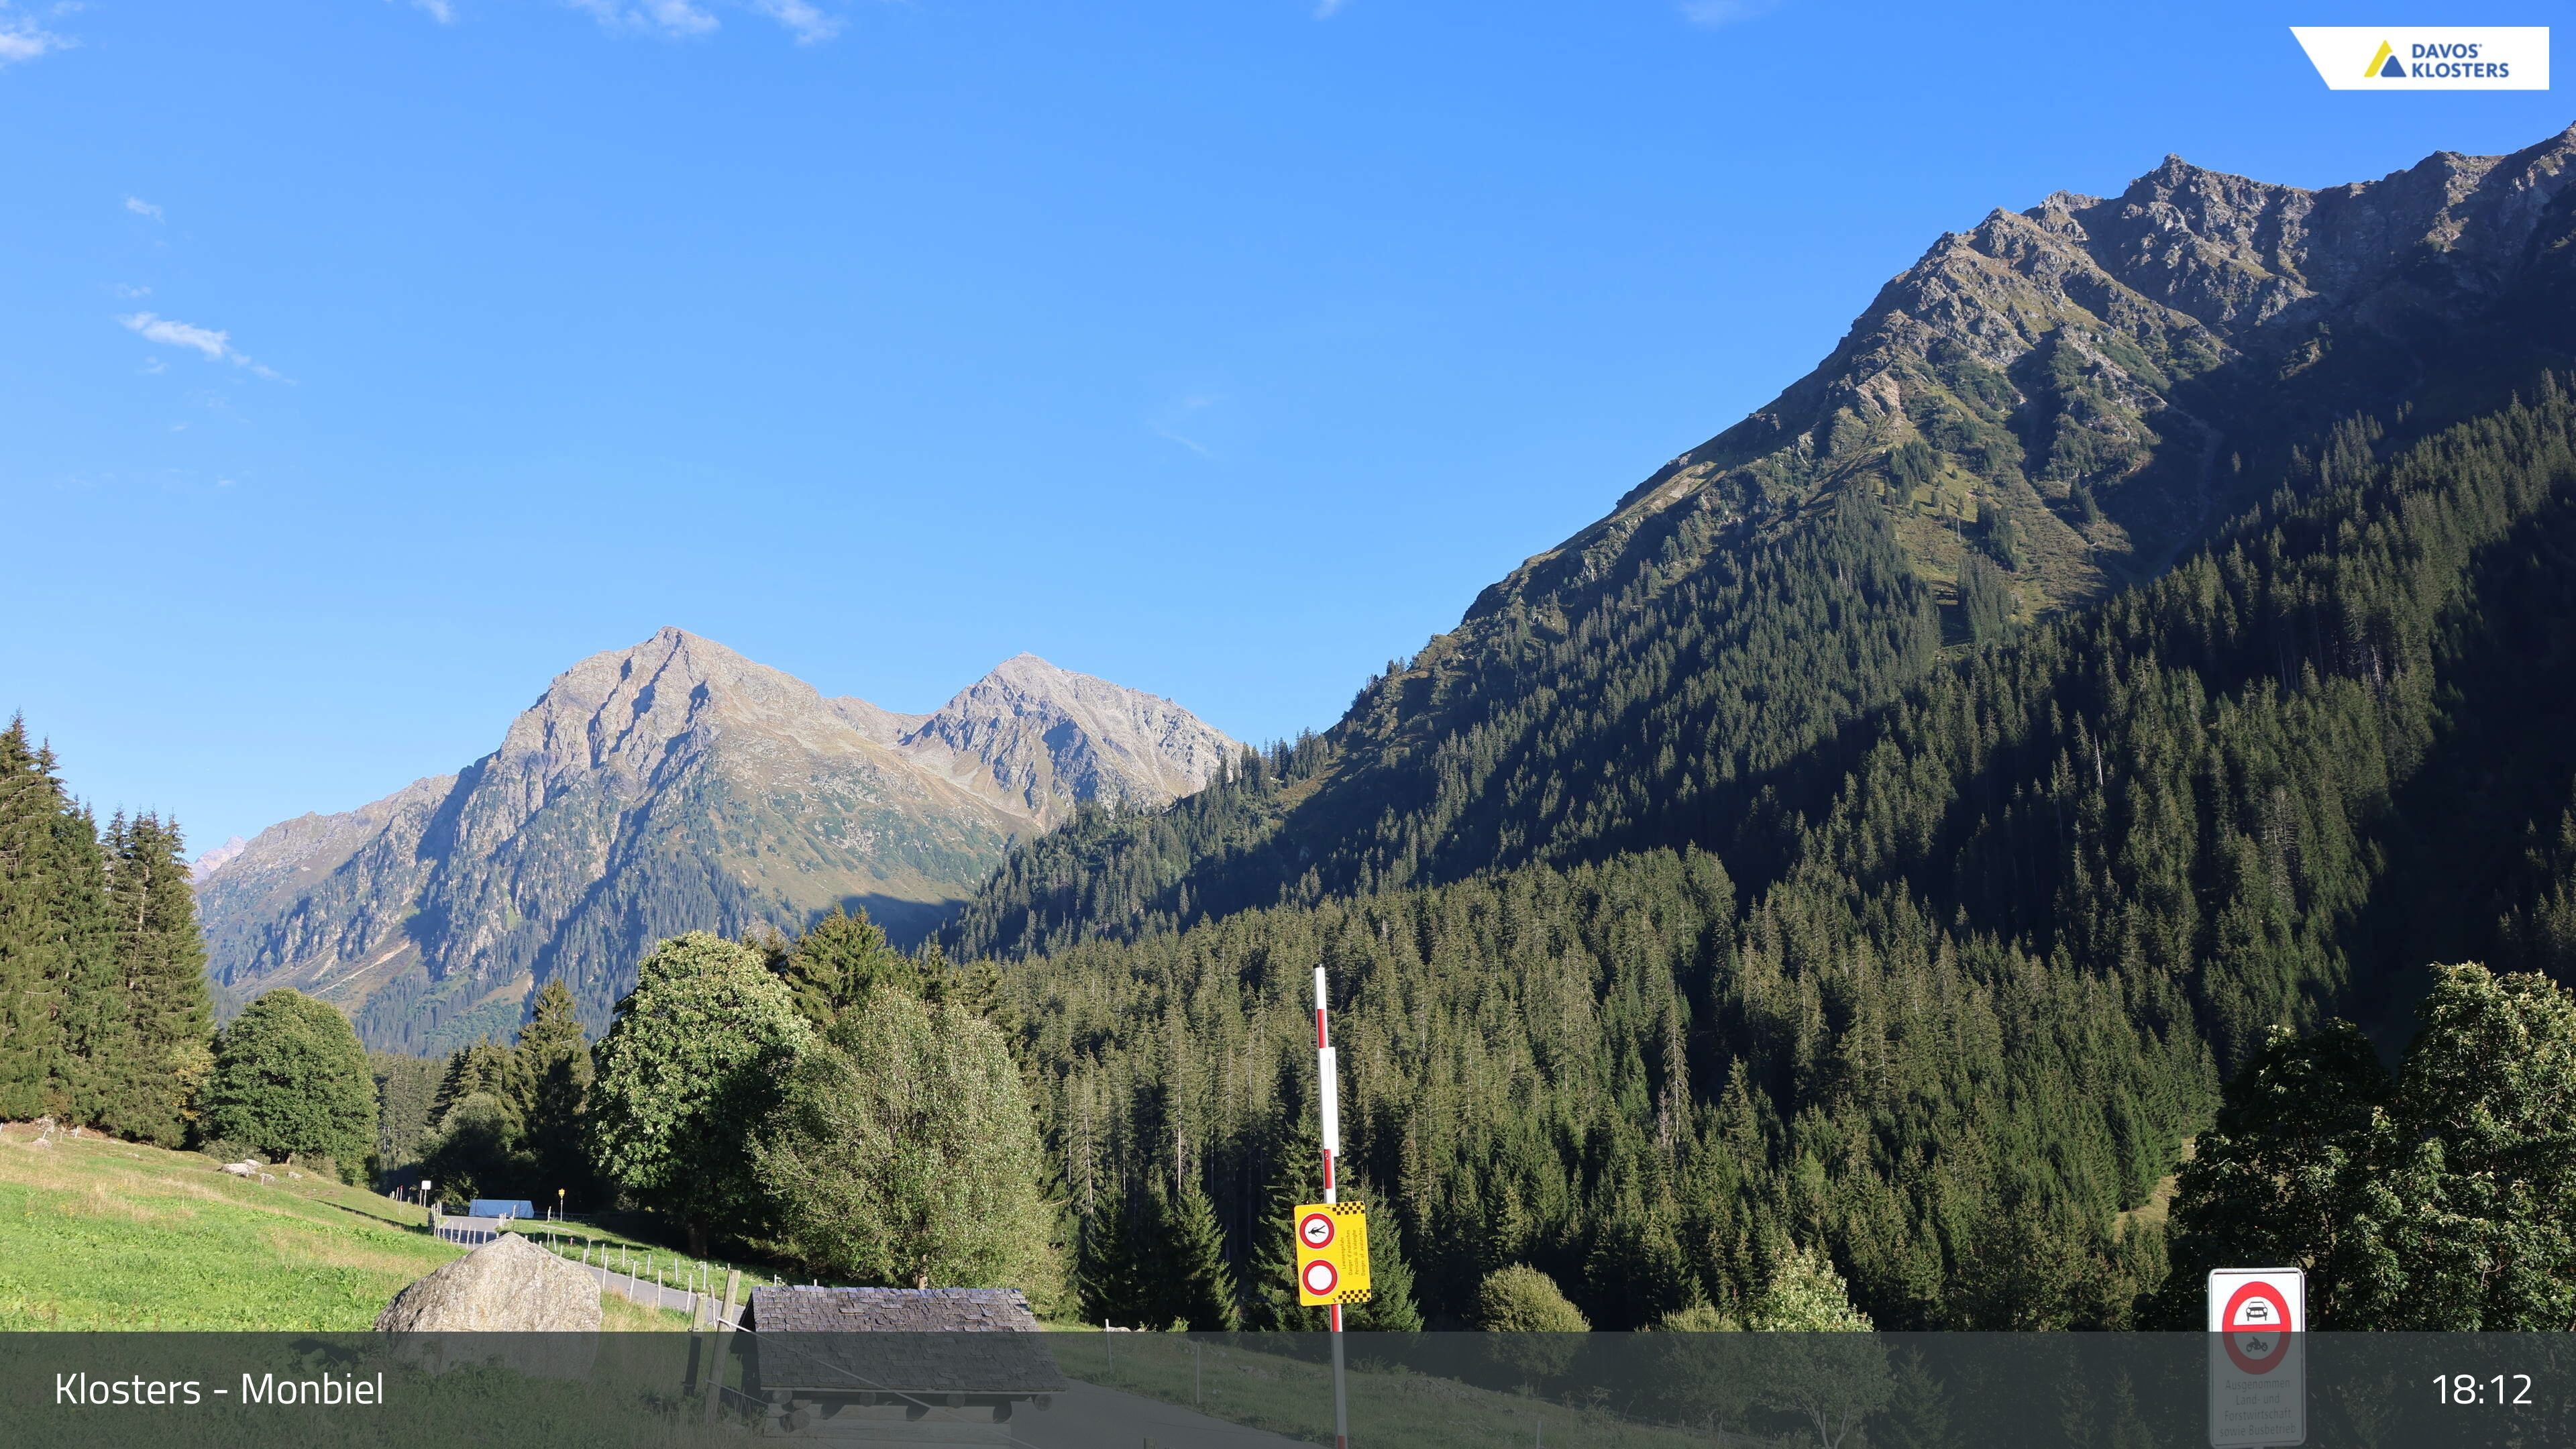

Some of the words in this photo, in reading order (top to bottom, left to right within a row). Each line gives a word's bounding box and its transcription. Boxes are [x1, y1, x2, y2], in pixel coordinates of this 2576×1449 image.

[2224, 1379, 2290, 1393] Ausgenommen
[2236, 1393, 2260, 1405] Land-
[2263, 1391, 2280, 1404] und
[2224, 1407, 2292, 1421] Forstwirtschaft
[2220, 1425, 2246, 1437] sowie
[2249, 1423, 2296, 1436] Busbetrieb
